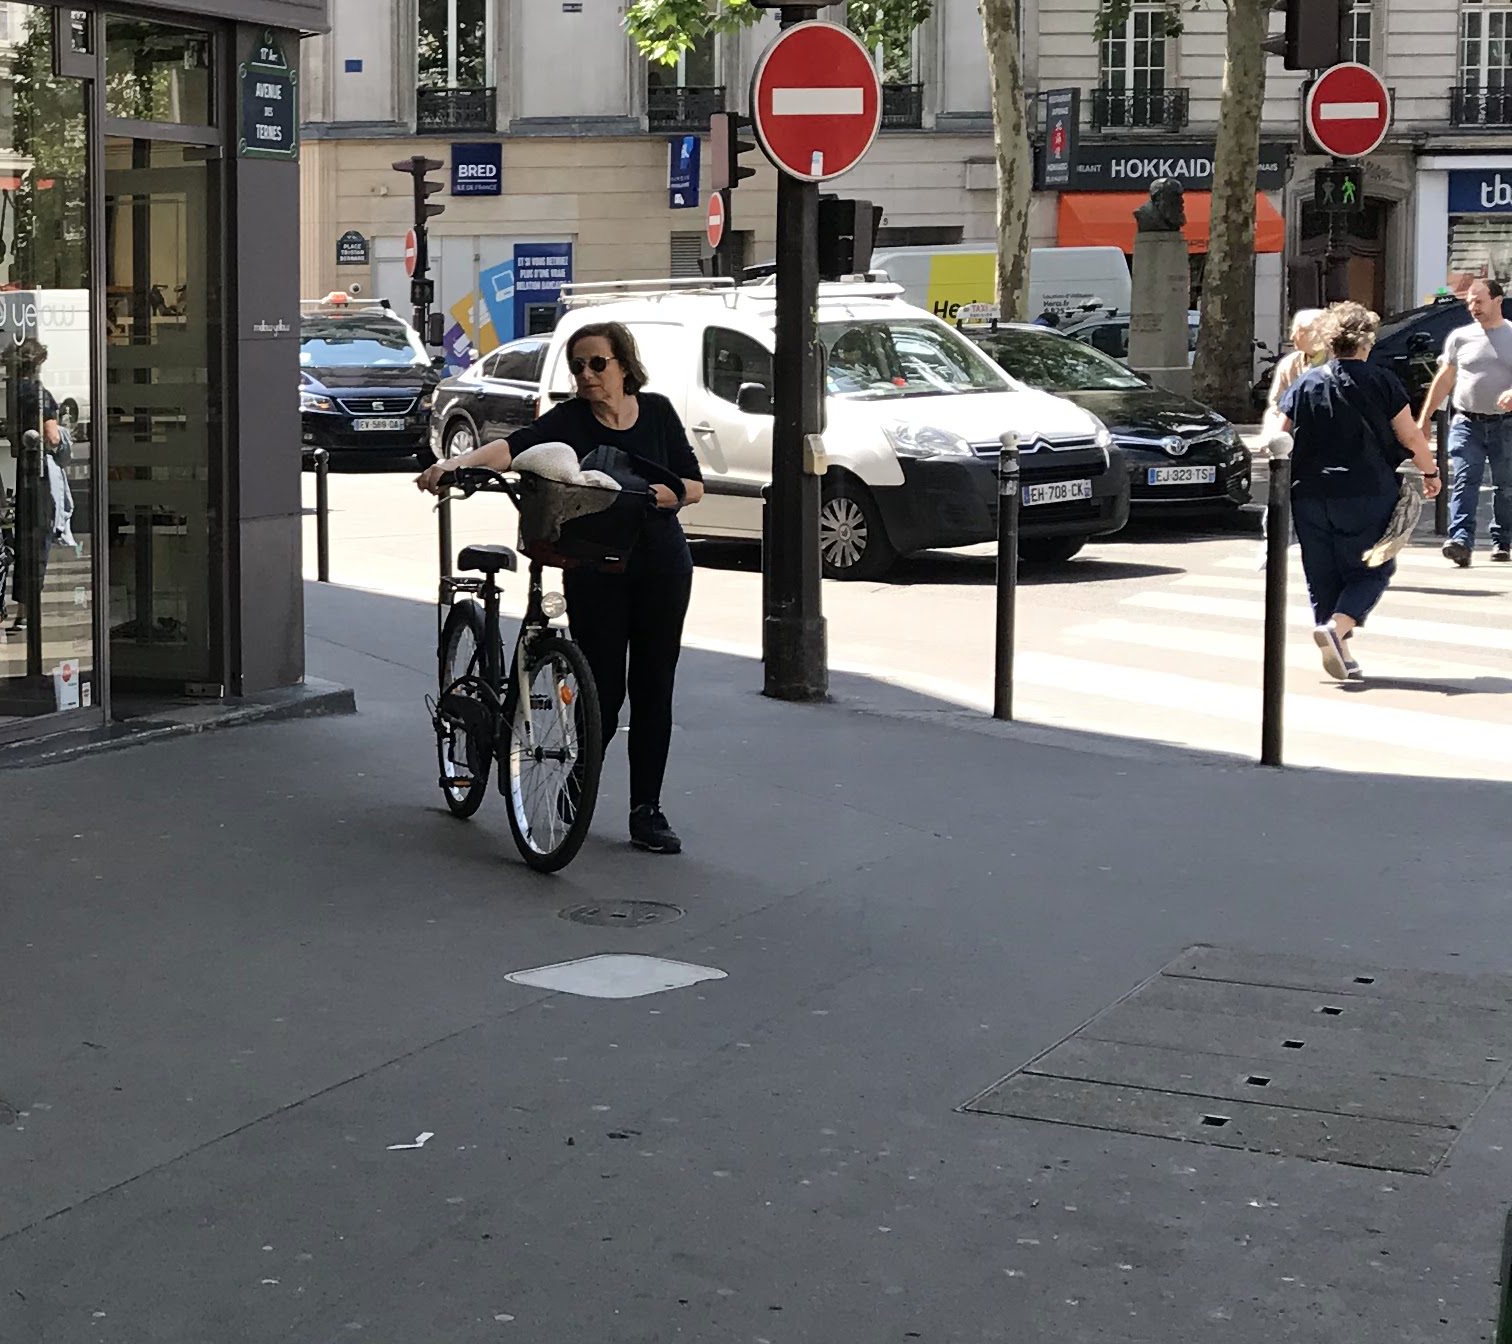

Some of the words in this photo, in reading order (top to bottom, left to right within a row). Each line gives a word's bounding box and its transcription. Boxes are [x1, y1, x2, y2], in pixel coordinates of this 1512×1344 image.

[255, 82, 283, 100] AVENUE
[255, 123, 283, 141] TERNES
[458, 164, 497, 177] BRED
[1077, 164, 1102, 173] RANT
[1480, 173, 1512, 208] tb
[1155, 468, 1209, 484] EJ-323-TS
[1029, 483, 1085, 502] EH-708-CK
